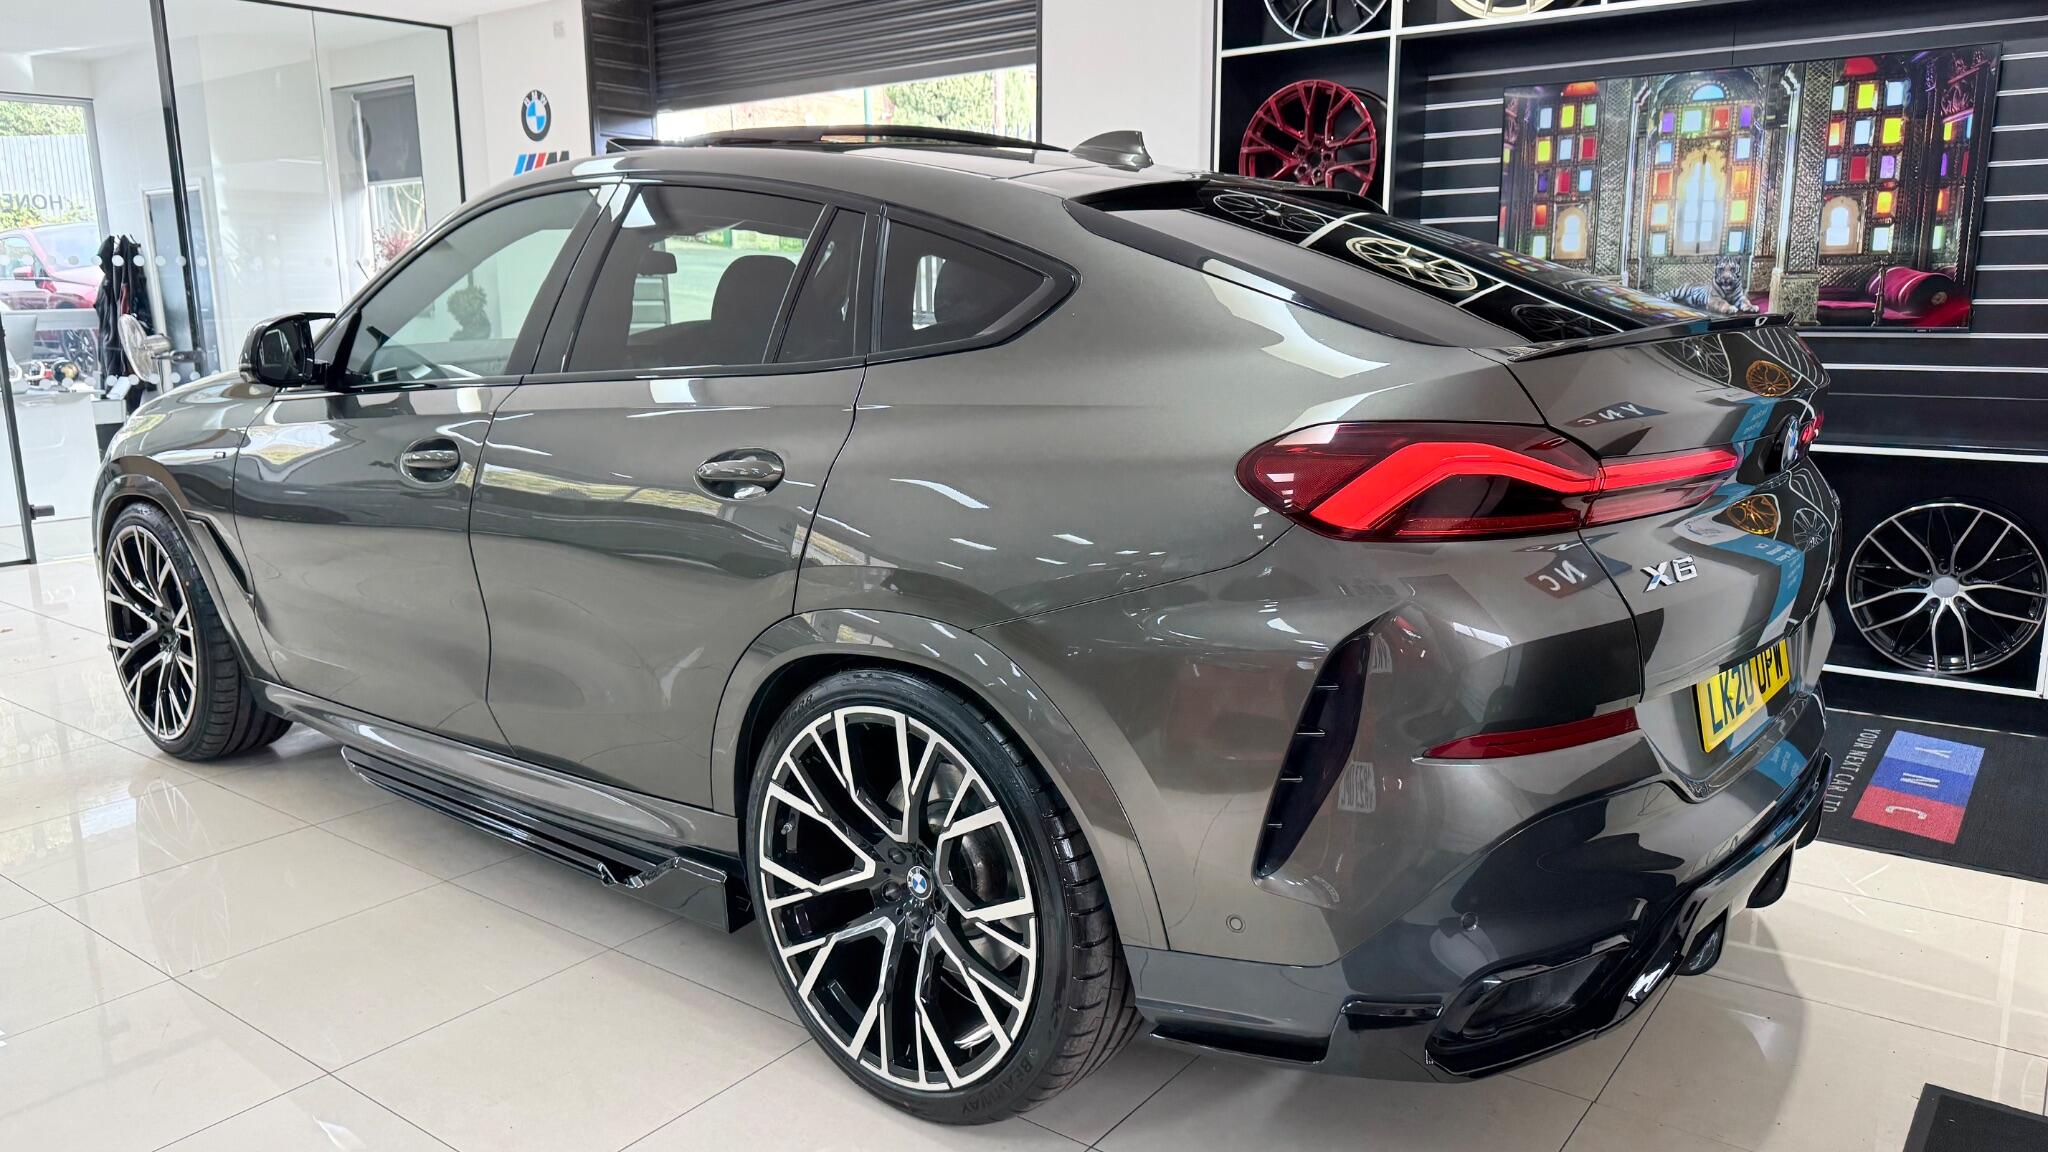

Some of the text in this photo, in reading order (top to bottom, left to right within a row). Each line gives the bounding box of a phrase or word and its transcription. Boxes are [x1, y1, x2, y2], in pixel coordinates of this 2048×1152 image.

[1640, 555, 1698, 593] X6
[1707, 659, 1755, 735] LK20
[1853, 728, 1882, 749] YOUR
[1840, 749, 1868, 773] NEXT
[1827, 773, 1855, 792] CAR
